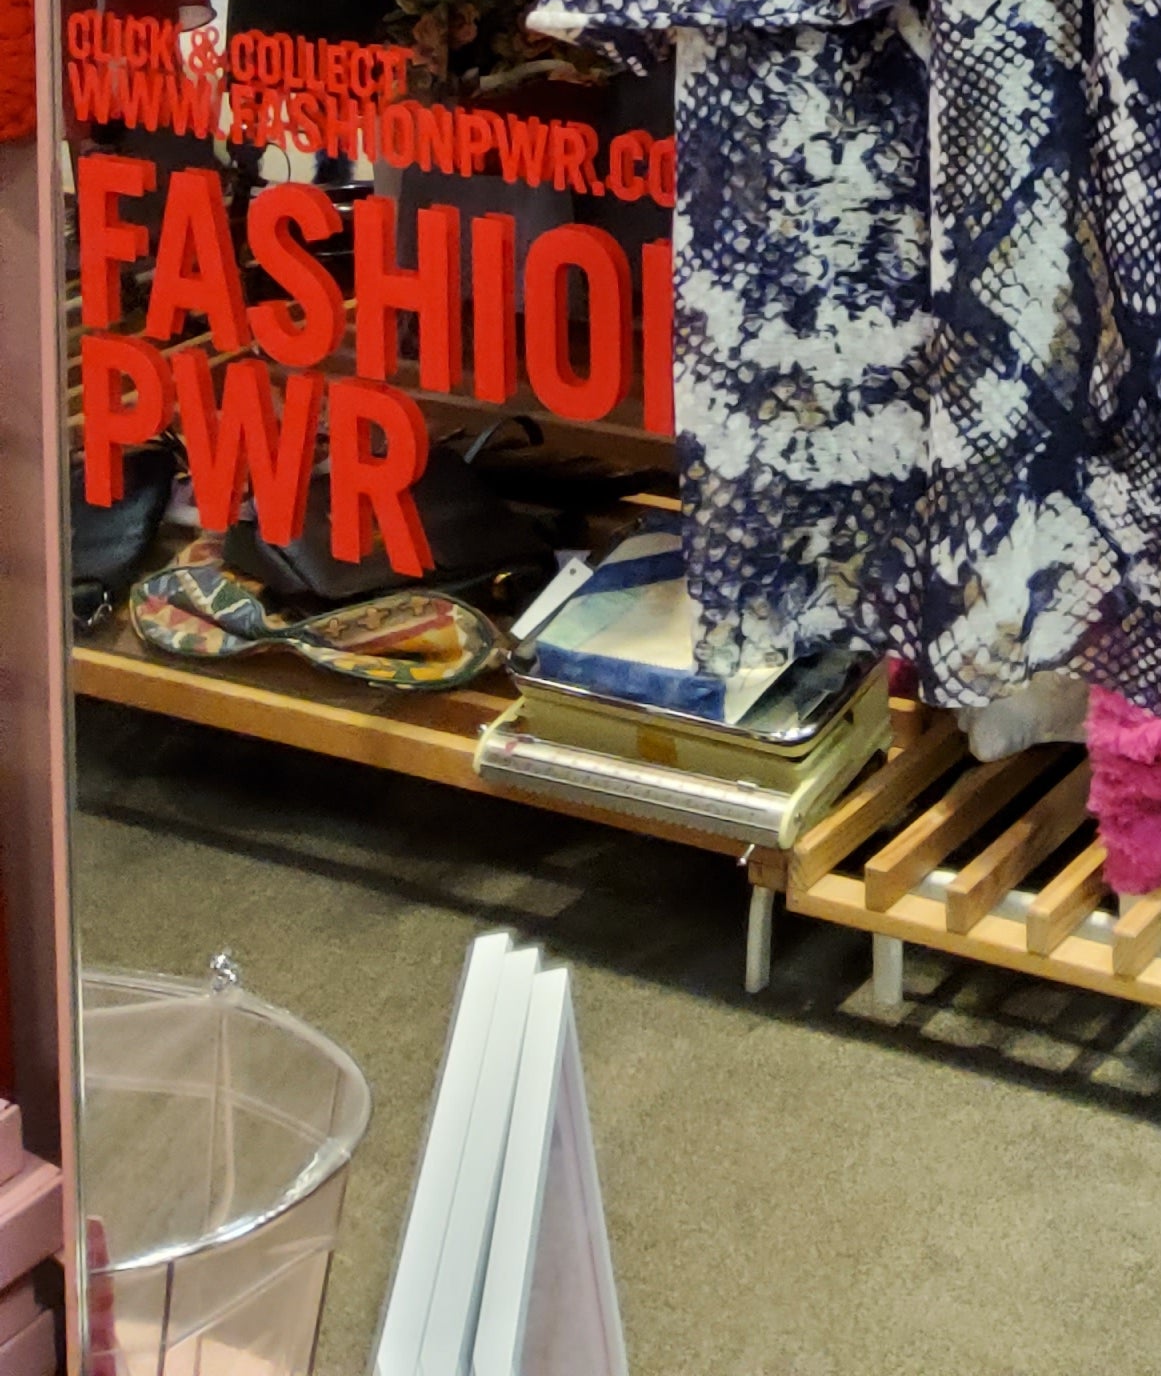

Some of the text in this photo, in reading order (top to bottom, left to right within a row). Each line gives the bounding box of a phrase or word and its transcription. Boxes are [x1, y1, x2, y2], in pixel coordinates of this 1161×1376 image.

[68, 10, 404, 105] CLICK & COLLECT
[81, 333, 435, 579] PWR
